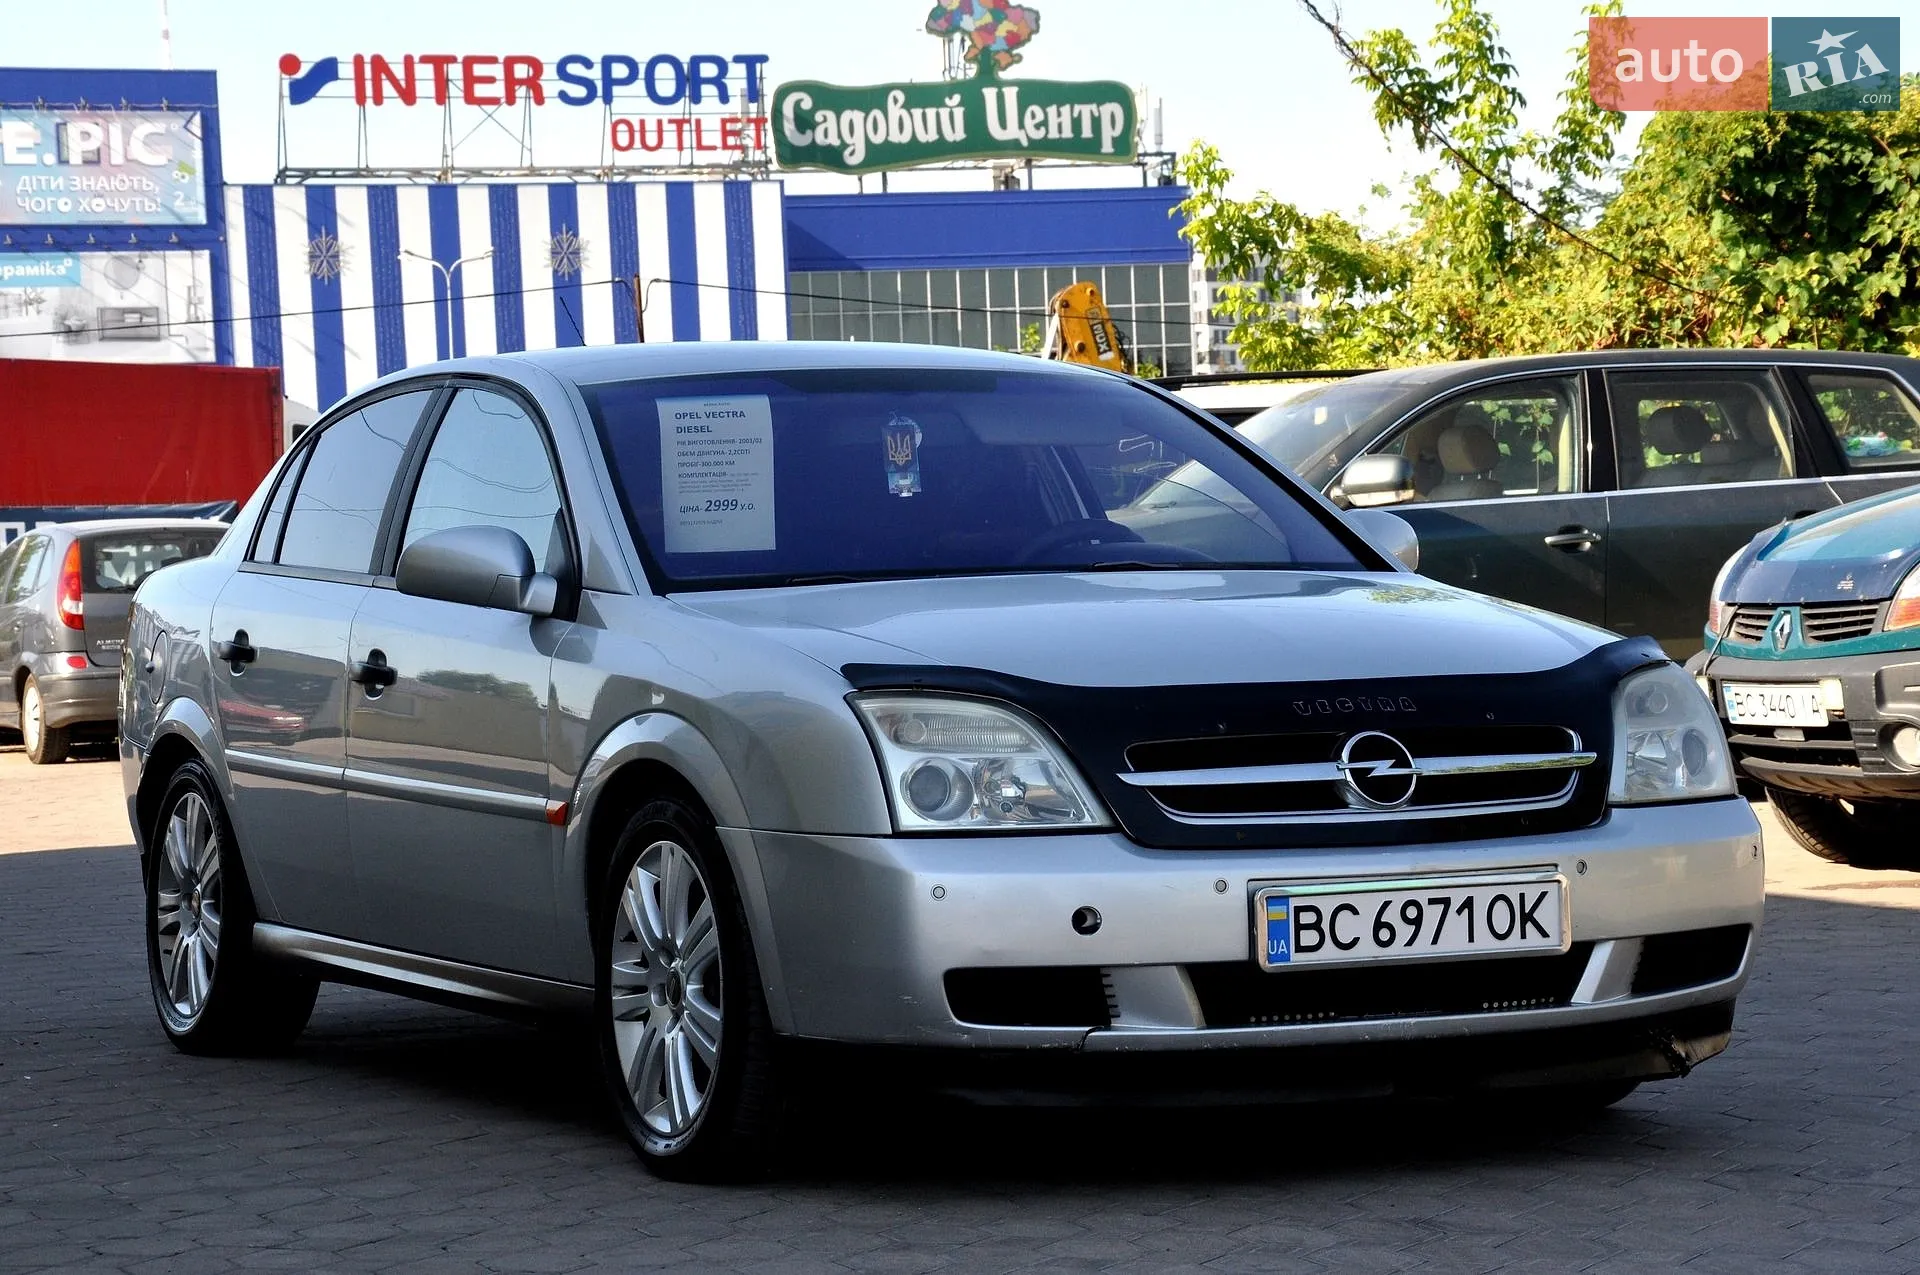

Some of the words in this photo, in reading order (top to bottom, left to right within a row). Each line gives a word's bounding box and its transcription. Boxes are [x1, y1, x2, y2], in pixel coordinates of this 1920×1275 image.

[353, 53, 770, 106] INTERSPORT
[611, 117, 769, 152] OUTLET
[782, 89, 967, 167] Садовий
[981, 85, 1125, 154] Центр
[16, 176, 64, 194] ДІТИ
[69, 174, 160, 193] ЗНАЮТЬ,
[16, 198, 72, 213] ЧОГО
[79, 196, 161, 213] ХОЧУТЬ!
[674, 411, 702, 420] OPEL
[704, 410, 746, 419] VECTRA
[676, 425, 713, 434] DIESEL
[704, 499, 738, 512] 2999
[1293, 902, 1361, 954] BC
[1372, 895, 1475, 949] 6971
[1486, 890, 1551, 942] OK
[1267, 938, 1288, 956] UA
